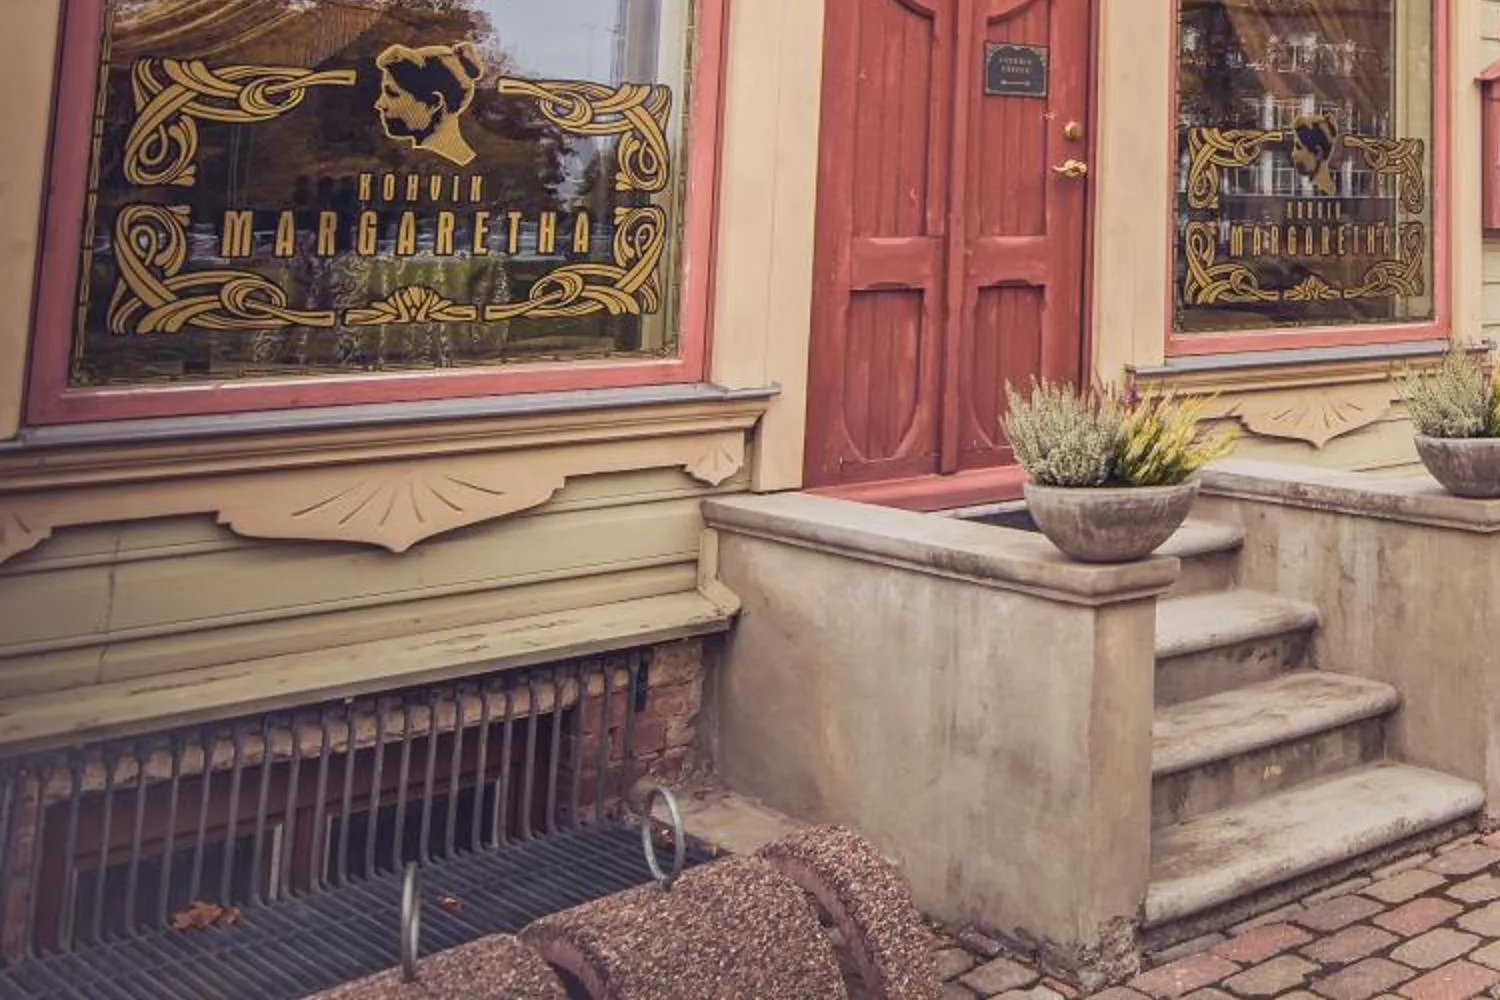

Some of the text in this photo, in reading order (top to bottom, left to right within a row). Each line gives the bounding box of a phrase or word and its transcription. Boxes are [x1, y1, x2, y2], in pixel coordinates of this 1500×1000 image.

[358, 172, 483, 201] KOHVIK
[220, 209, 590, 257] MARGARETHA
[1230, 225, 1390, 257] MARGARETHA
